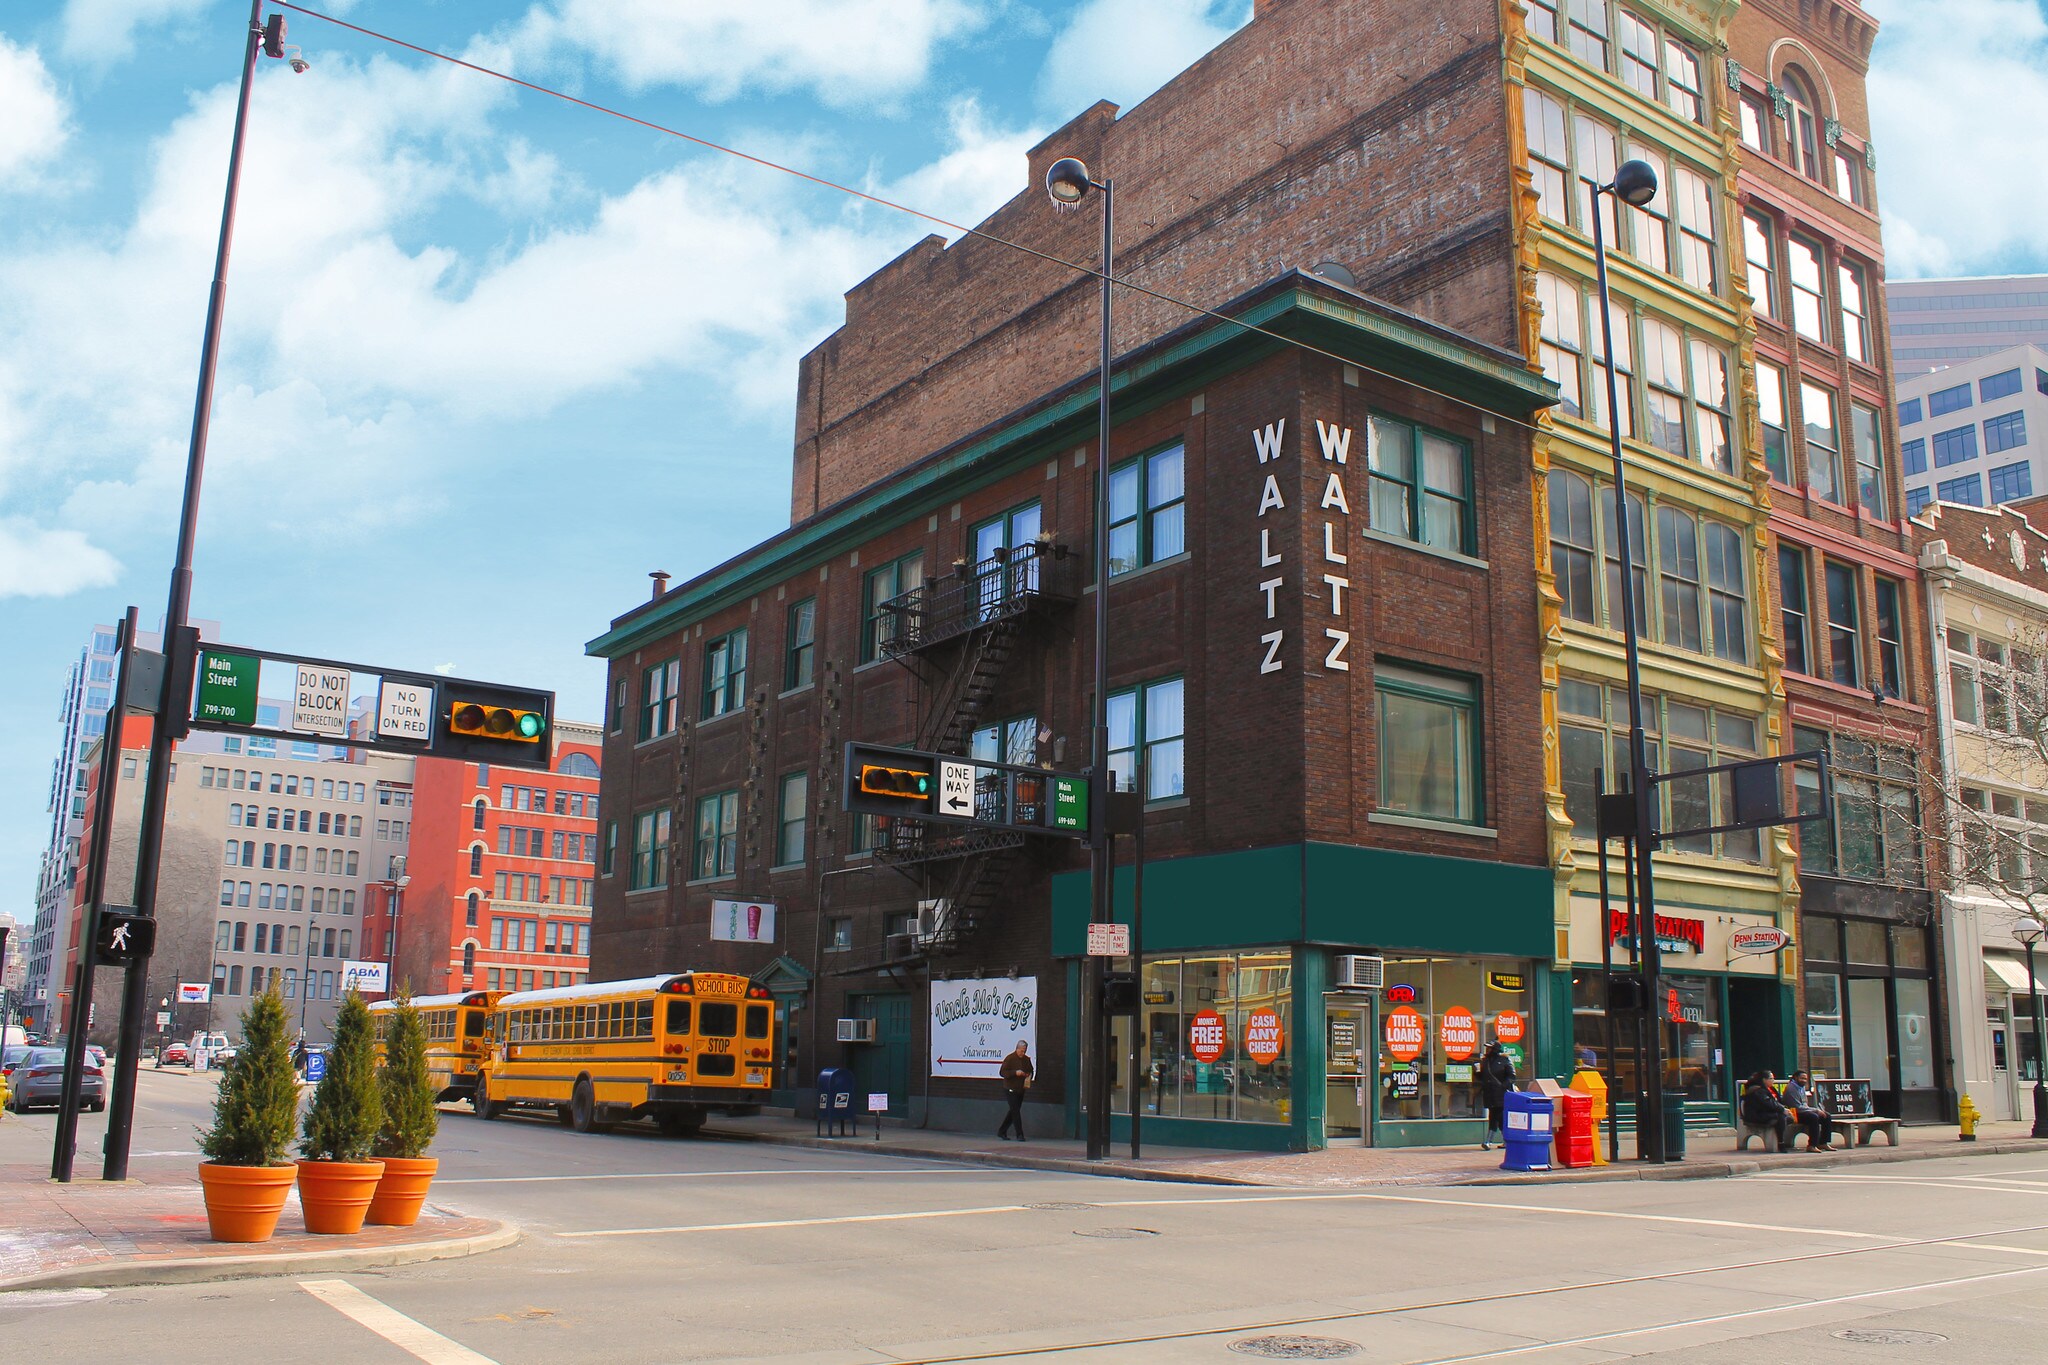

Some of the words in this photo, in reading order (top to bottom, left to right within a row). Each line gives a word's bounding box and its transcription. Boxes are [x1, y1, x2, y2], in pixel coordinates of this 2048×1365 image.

[1252, 417, 1286, 675] WALTZ
[1315, 419, 1352, 672] WALTZ
[209, 657, 231, 671] Main
[207, 673, 238, 687] Street
[300, 672, 318, 688] DO
[321, 675, 346, 691] NOT
[299, 692, 342, 712] BLOCK
[398, 691, 417, 703] NO
[204, 703, 236, 717] 799-700
[391, 704, 421, 717] TURN
[295, 713, 343, 728] INTERSECTION
[383, 718, 400, 730] ON
[403, 720, 426, 732] RED
[946, 766, 969, 780] ONE
[945, 780, 970, 794] WAY
[1058, 781, 1072, 792] Main
[1058, 793, 1076, 804] Street
[1058, 816, 1077, 826] 699-600
[1654, 913, 1704, 954] STATION
[1734, 934, 1752, 948] PENN
[1754, 932, 1780, 945] STATION
[348, 968, 379, 977] ABM
[697, 980, 726, 994] SCHOOL
[728, 982, 743, 995] BUS
[935, 987, 970, 1027] Uncle
[972, 986, 1001, 1016] Mo's
[1002, 992, 1034, 1031] Café
[1683, 1007, 1702, 1023] OPEN
[1197, 1018, 1217, 1026] MONEY
[1251, 1015, 1276, 1028] CASH
[1392, 1015, 1417, 1027] TITLE
[1444, 1016, 1472, 1028] LOANS
[1498, 1015, 1514, 1025] Send
[1513, 1017, 1519, 1025] A
[972, 1021, 993, 1035] Gyros
[1248, 1028, 1279, 1040] ANY
[1498, 1025, 1520, 1036] Friend
[979, 1035, 985, 1046] &
[1191, 1026, 1223, 1044] FREE
[1387, 1028, 1422, 1042] LOANS
[1441, 1028, 1475, 1043] $10,000
[708, 1038, 731, 1053] STOP
[962, 1045, 1002, 1058] Shawarma
[1195, 1045, 1219, 1053] ORDERS
[1248, 1041, 1279, 1054] CHECK
[1391, 1044, 1406, 1052] CASH
[1406, 1044, 1419, 1052] NOW
[1504, 1046, 1516, 1055] Earn
[312, 1057, 320, 1068] P
[1392, 1072, 1418, 1086] $1,000
[1834, 1084, 1852, 1092] SLICK
[1836, 1094, 1853, 1102] BANG
